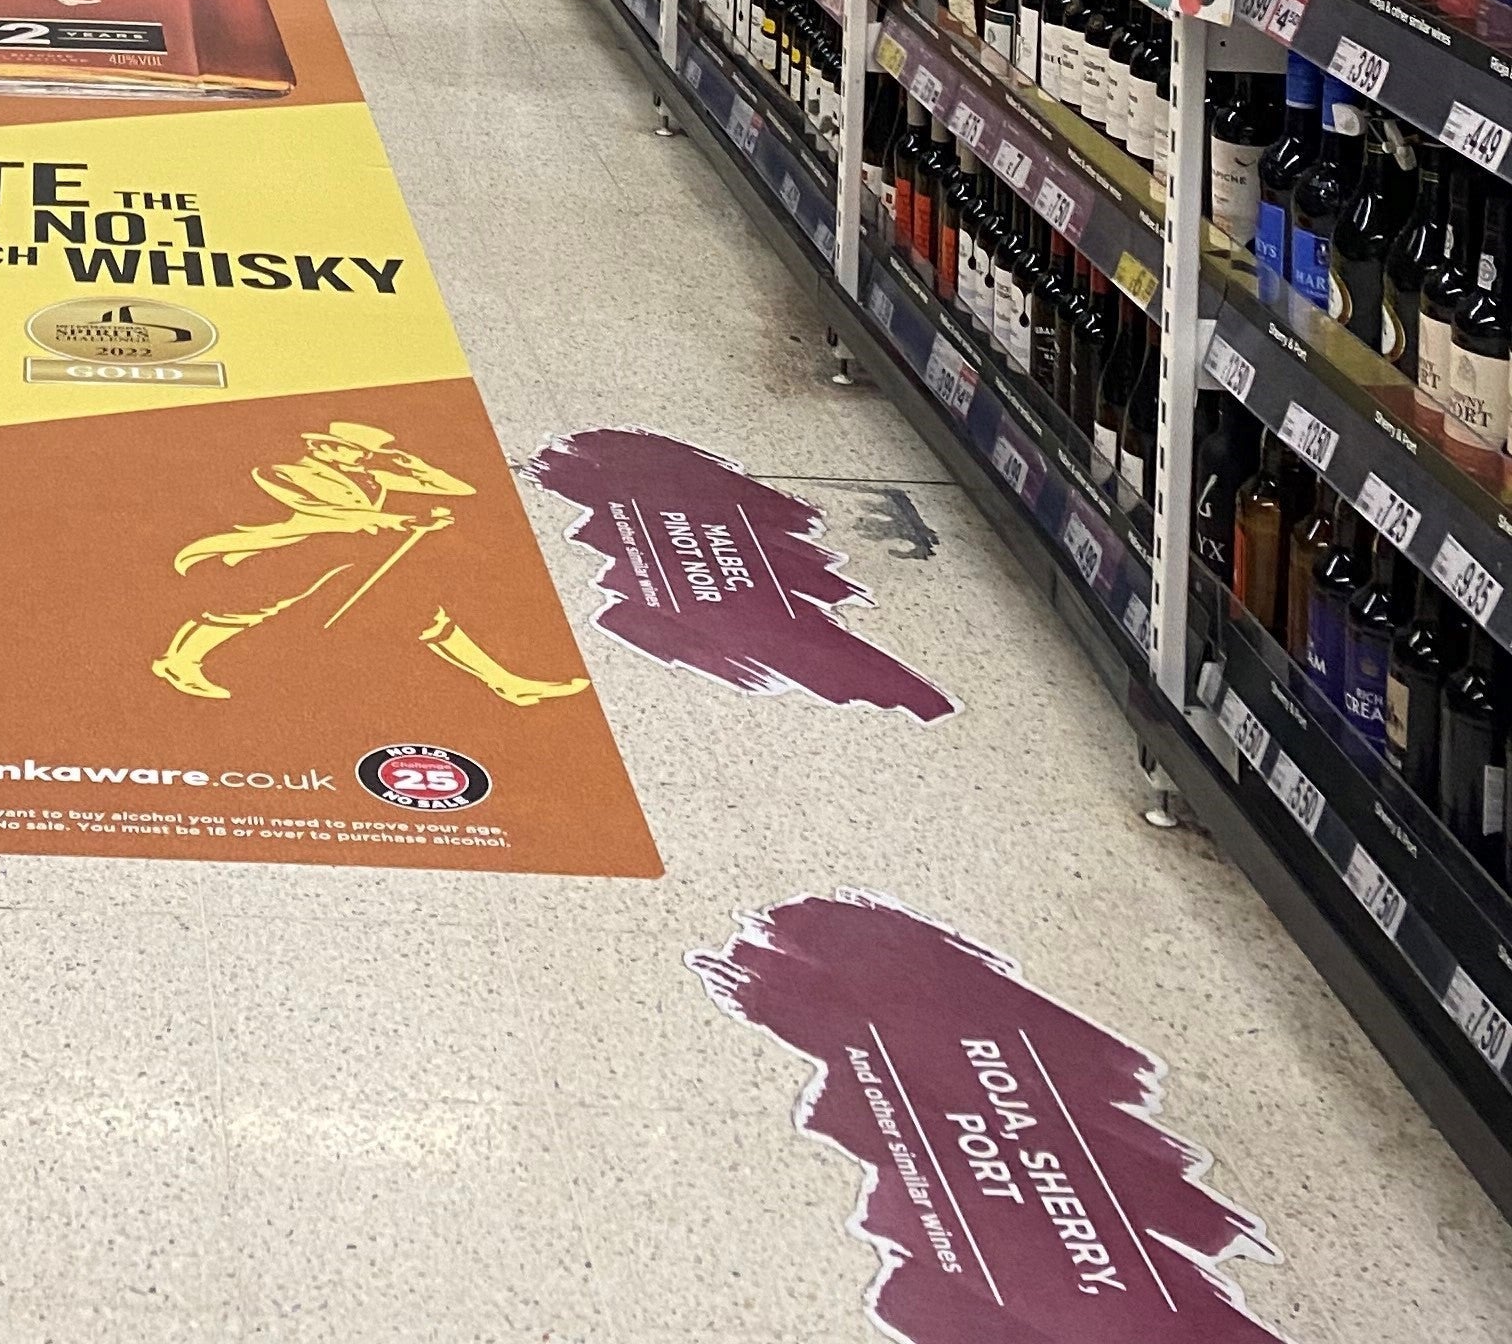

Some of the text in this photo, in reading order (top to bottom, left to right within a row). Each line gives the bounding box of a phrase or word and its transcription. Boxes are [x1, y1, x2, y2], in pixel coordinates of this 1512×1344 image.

[114, 191, 199, 211] THE
[34, 209, 208, 248] NO.1
[65, 248, 406, 293] WHISKY
[96, 347, 152, 357] 2022
[67, 365, 183, 379] GOLD
[608, 502, 660, 609] And other similar wines
[660, 511, 722, 603] PINOT NOIR
[702, 523, 754, 593] MALBEC,
[1345, 693, 1385, 723] CREA
[387, 746, 416, 757] NO
[392, 769, 459, 792] 25
[383, 790, 469, 809] NO SALE
[42, 809, 63, 820] to
[68, 810, 105, 822] buy
[111, 812, 182, 824] alcohol
[189, 815, 225, 826] you
[232, 816, 264, 826] will
[271, 817, 319, 828] need
[325, 819, 346, 829] to
[352, 821, 408, 832] prove
[414, 822, 459, 834] your
[466, 825, 508, 836] age.
[845, 1046, 962, 1275] And other similar wines
[945, 1112, 1024, 1205] PORT
[960, 1038, 1127, 1295] RIOJA, SHERRY,
